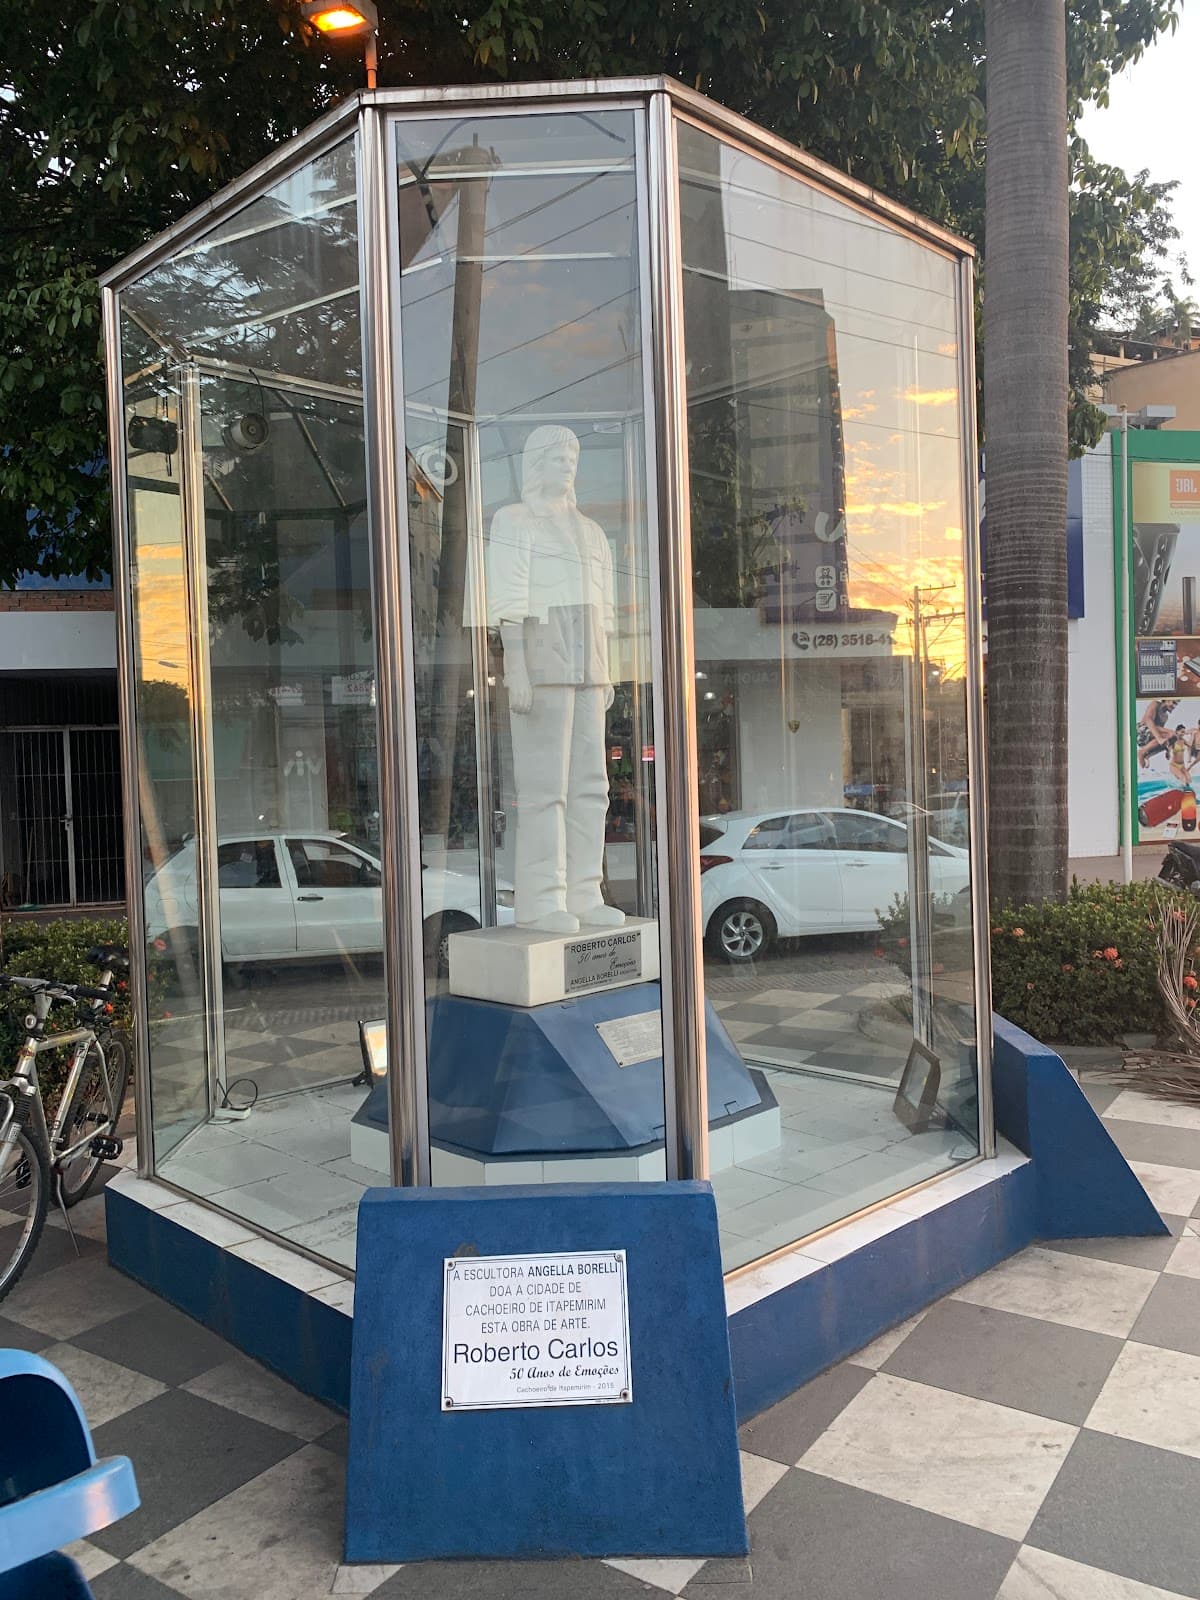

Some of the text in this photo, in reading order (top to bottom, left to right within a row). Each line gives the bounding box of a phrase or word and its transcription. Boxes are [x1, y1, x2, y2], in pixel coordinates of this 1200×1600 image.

[1176, 478, 1198, 494] JBL
[813, 633, 838, 649] (28)
[571, 935, 636, 953] ROBERTO CARLOS
[570, 975, 596, 985] ANGELLA
[597, 970, 619, 980] BORELLI
[453, 1262, 618, 1281] A ESCULTORA ANGELLA BORELLI
[489, 1281, 582, 1297] DOA A CIDADE DE
[465, 1298, 606, 1316] CACHOEIRO DE ITAPEMIRIM
[481, 1317, 591, 1334] ESTA OBRA DE ARTE.
[454, 1337, 618, 1364] Roberto Carlos
[509, 1364, 619, 1380] 50 Anos de Emoções
[559, 1383, 591, 1392] Itapemirim
